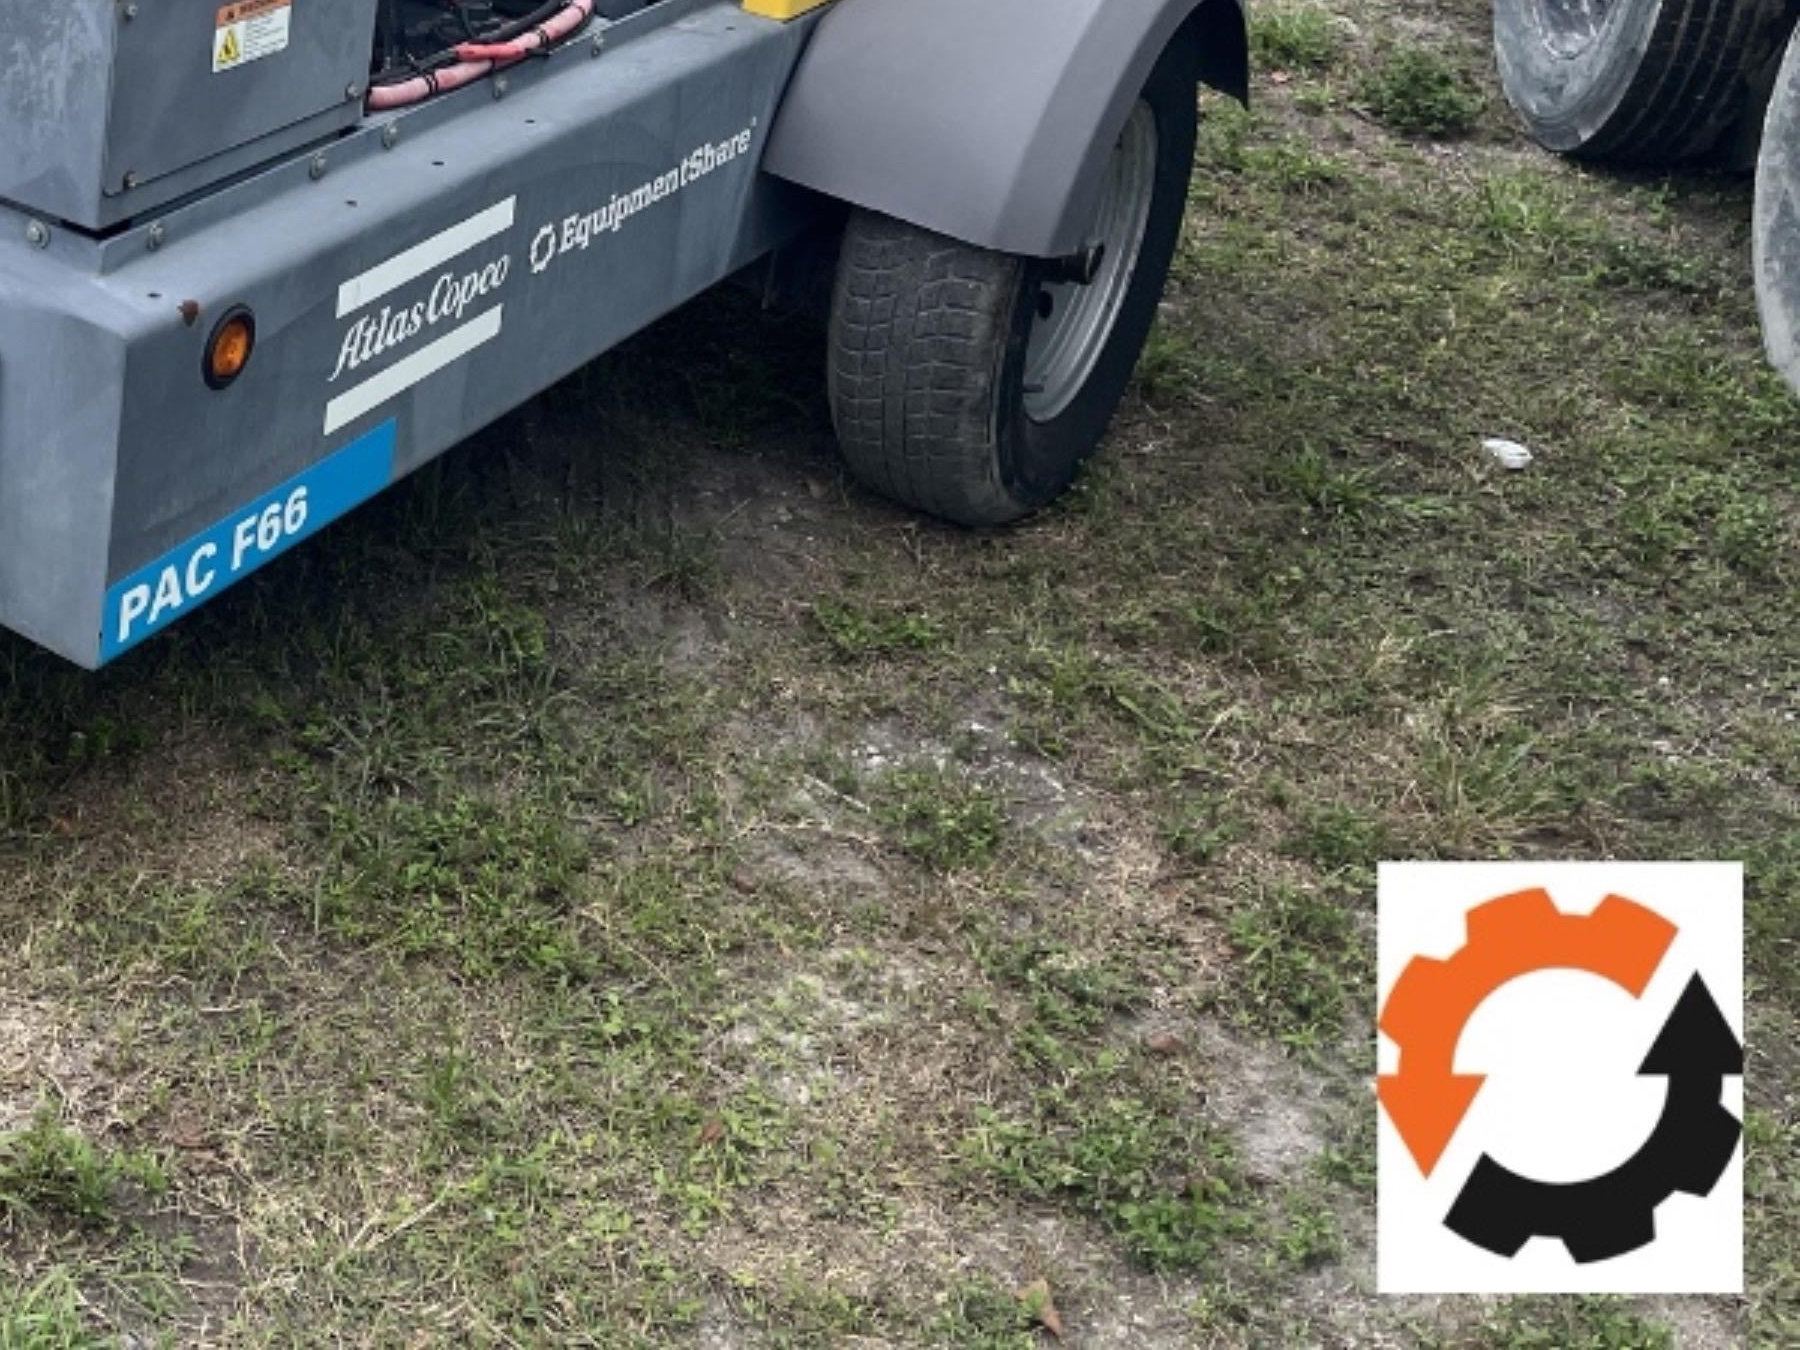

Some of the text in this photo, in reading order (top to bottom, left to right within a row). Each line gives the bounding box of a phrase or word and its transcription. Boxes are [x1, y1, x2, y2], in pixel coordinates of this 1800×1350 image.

[558, 128, 751, 254] EquipmentShare
[328, 254, 510, 381] Atlas Copco
[118, 486, 308, 642] PAC F66
